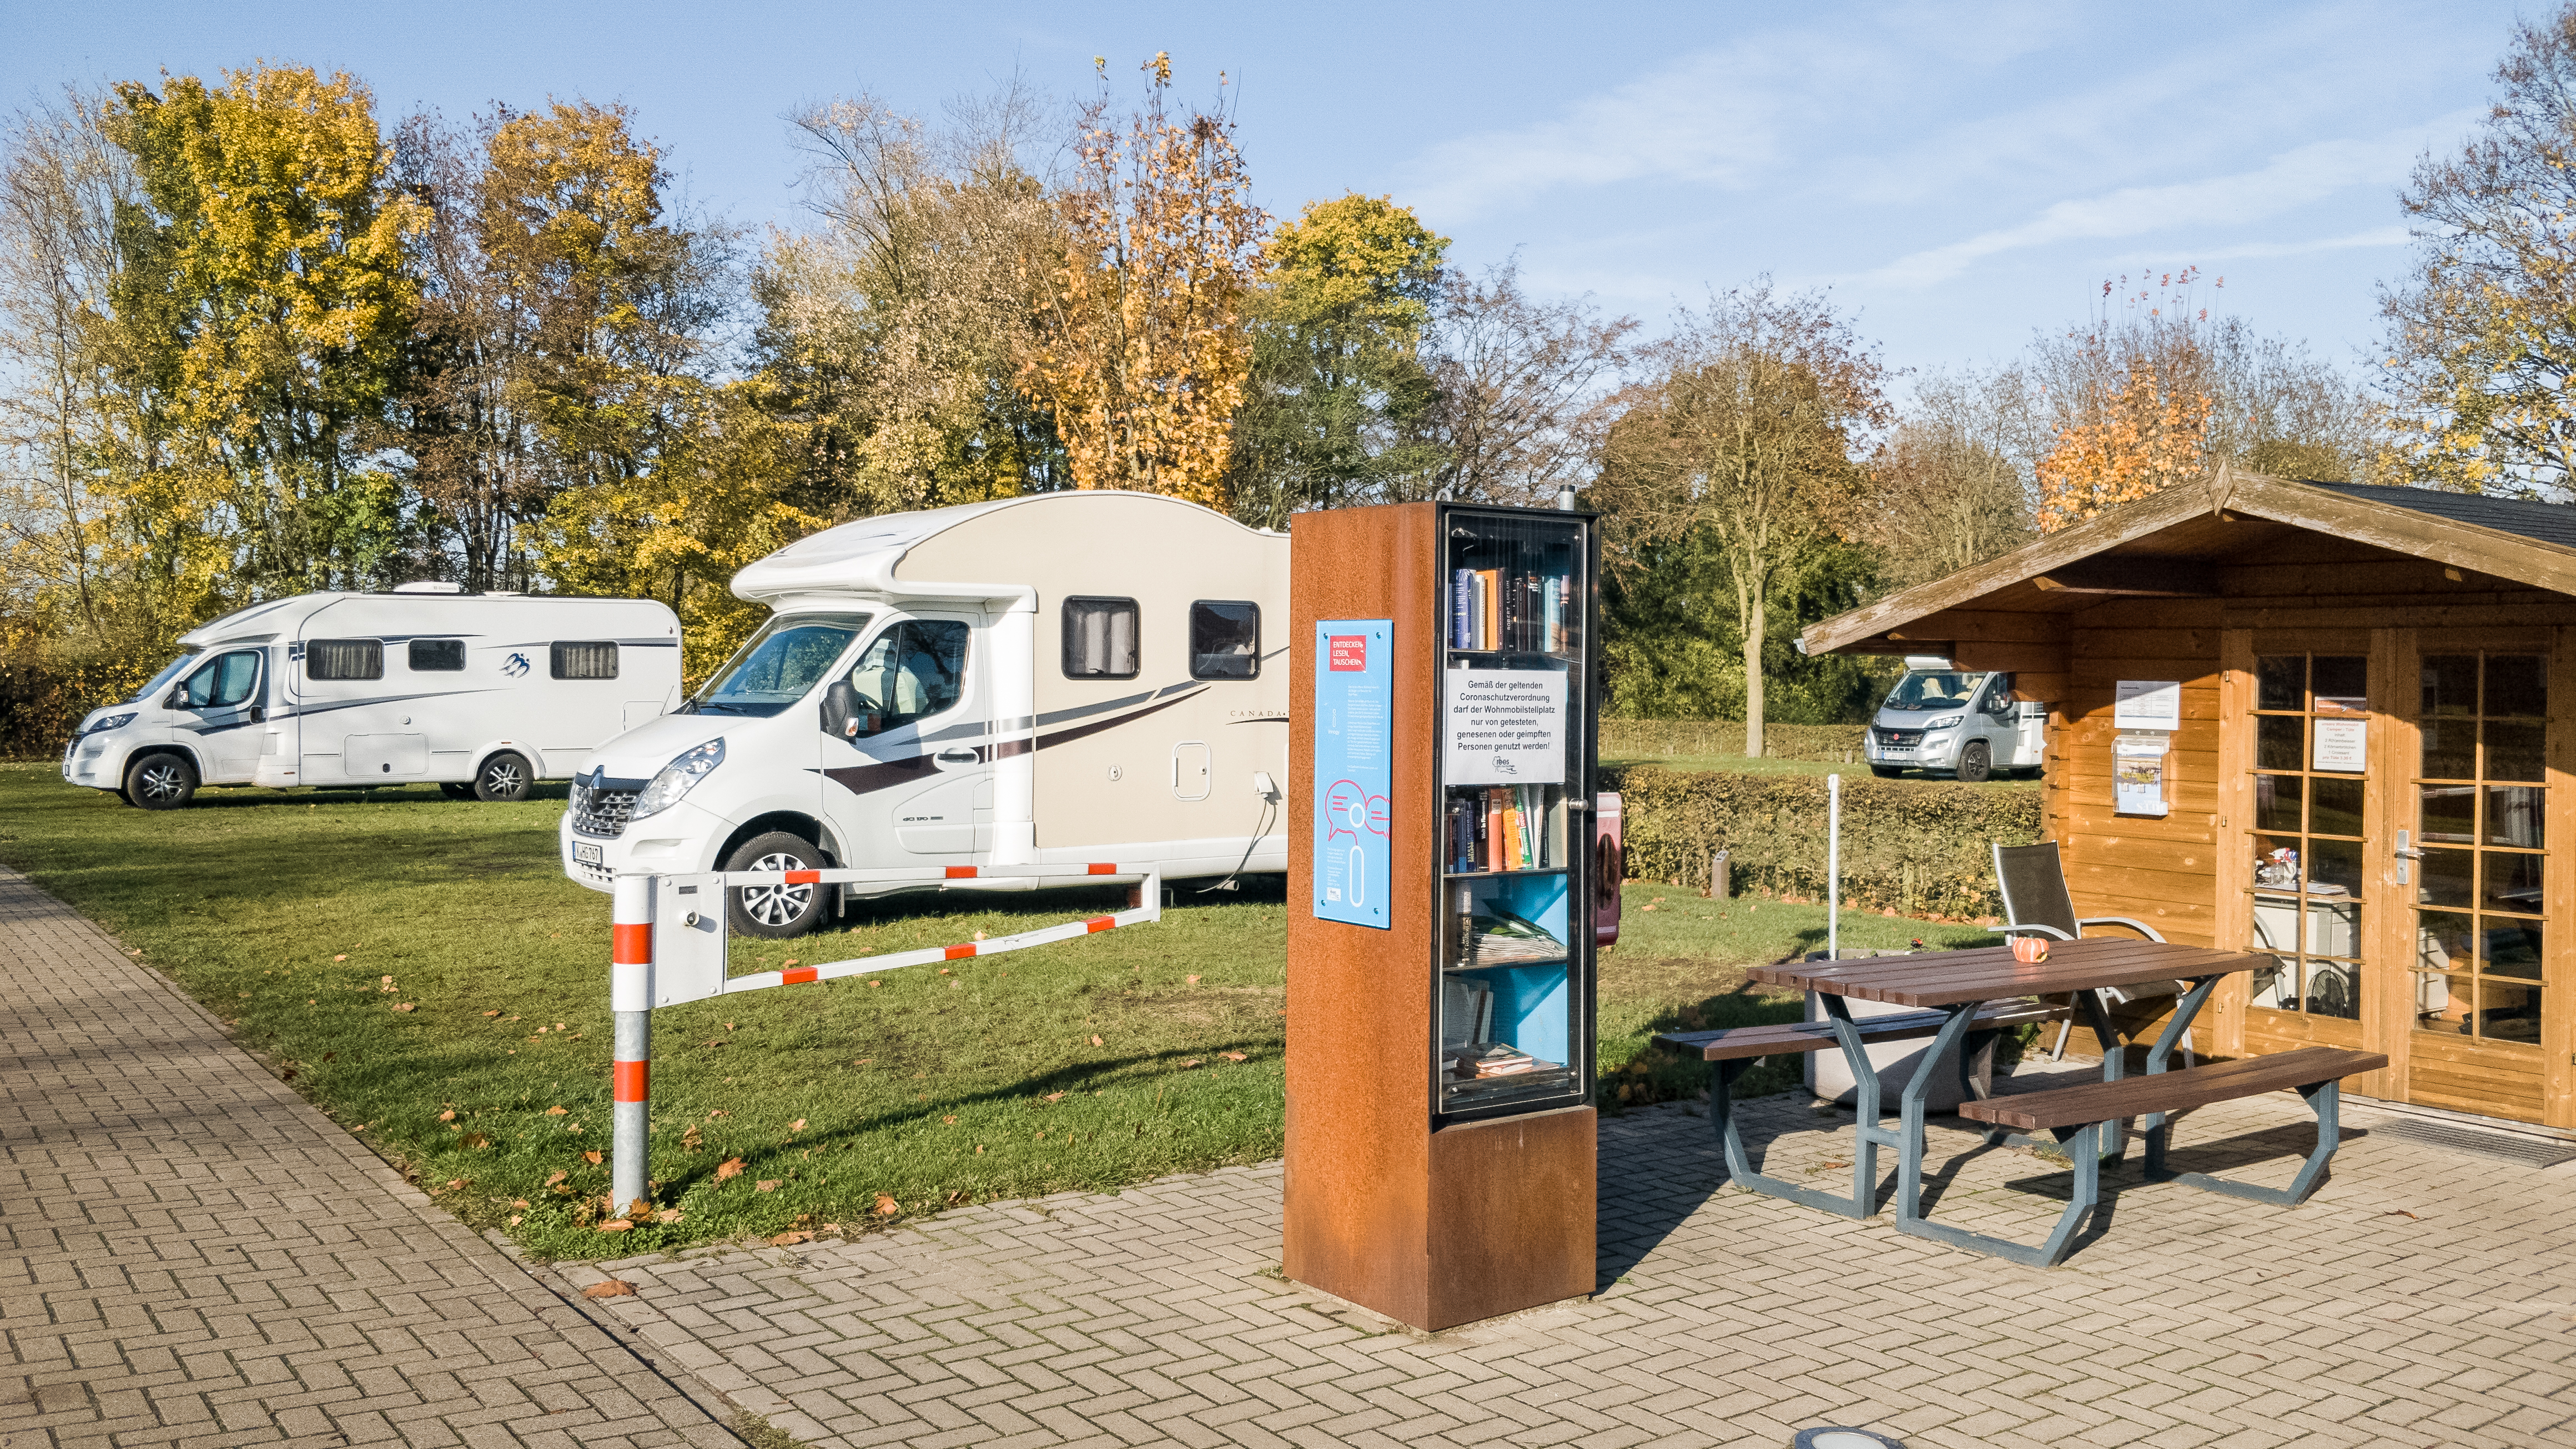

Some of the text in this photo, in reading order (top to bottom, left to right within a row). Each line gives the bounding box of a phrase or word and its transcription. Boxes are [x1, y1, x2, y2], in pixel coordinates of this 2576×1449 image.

[1468, 680, 1543, 691] Gemäß der geltenden
[1460, 693, 1550, 703] Coronaschutzverordnung
[1484, 706, 1555, 715] Wohnmobilstellplatz
[1500, 718, 1538, 727] getesteten,
[1457, 731, 1497, 739] genesenen
[1516, 730, 1551, 739] geimpften
[1494, 742, 1521, 752] genutzt
[1522, 742, 1550, 750] werden!
[576, 844, 580, 858] K
[588, 847, 598, 861] 767
